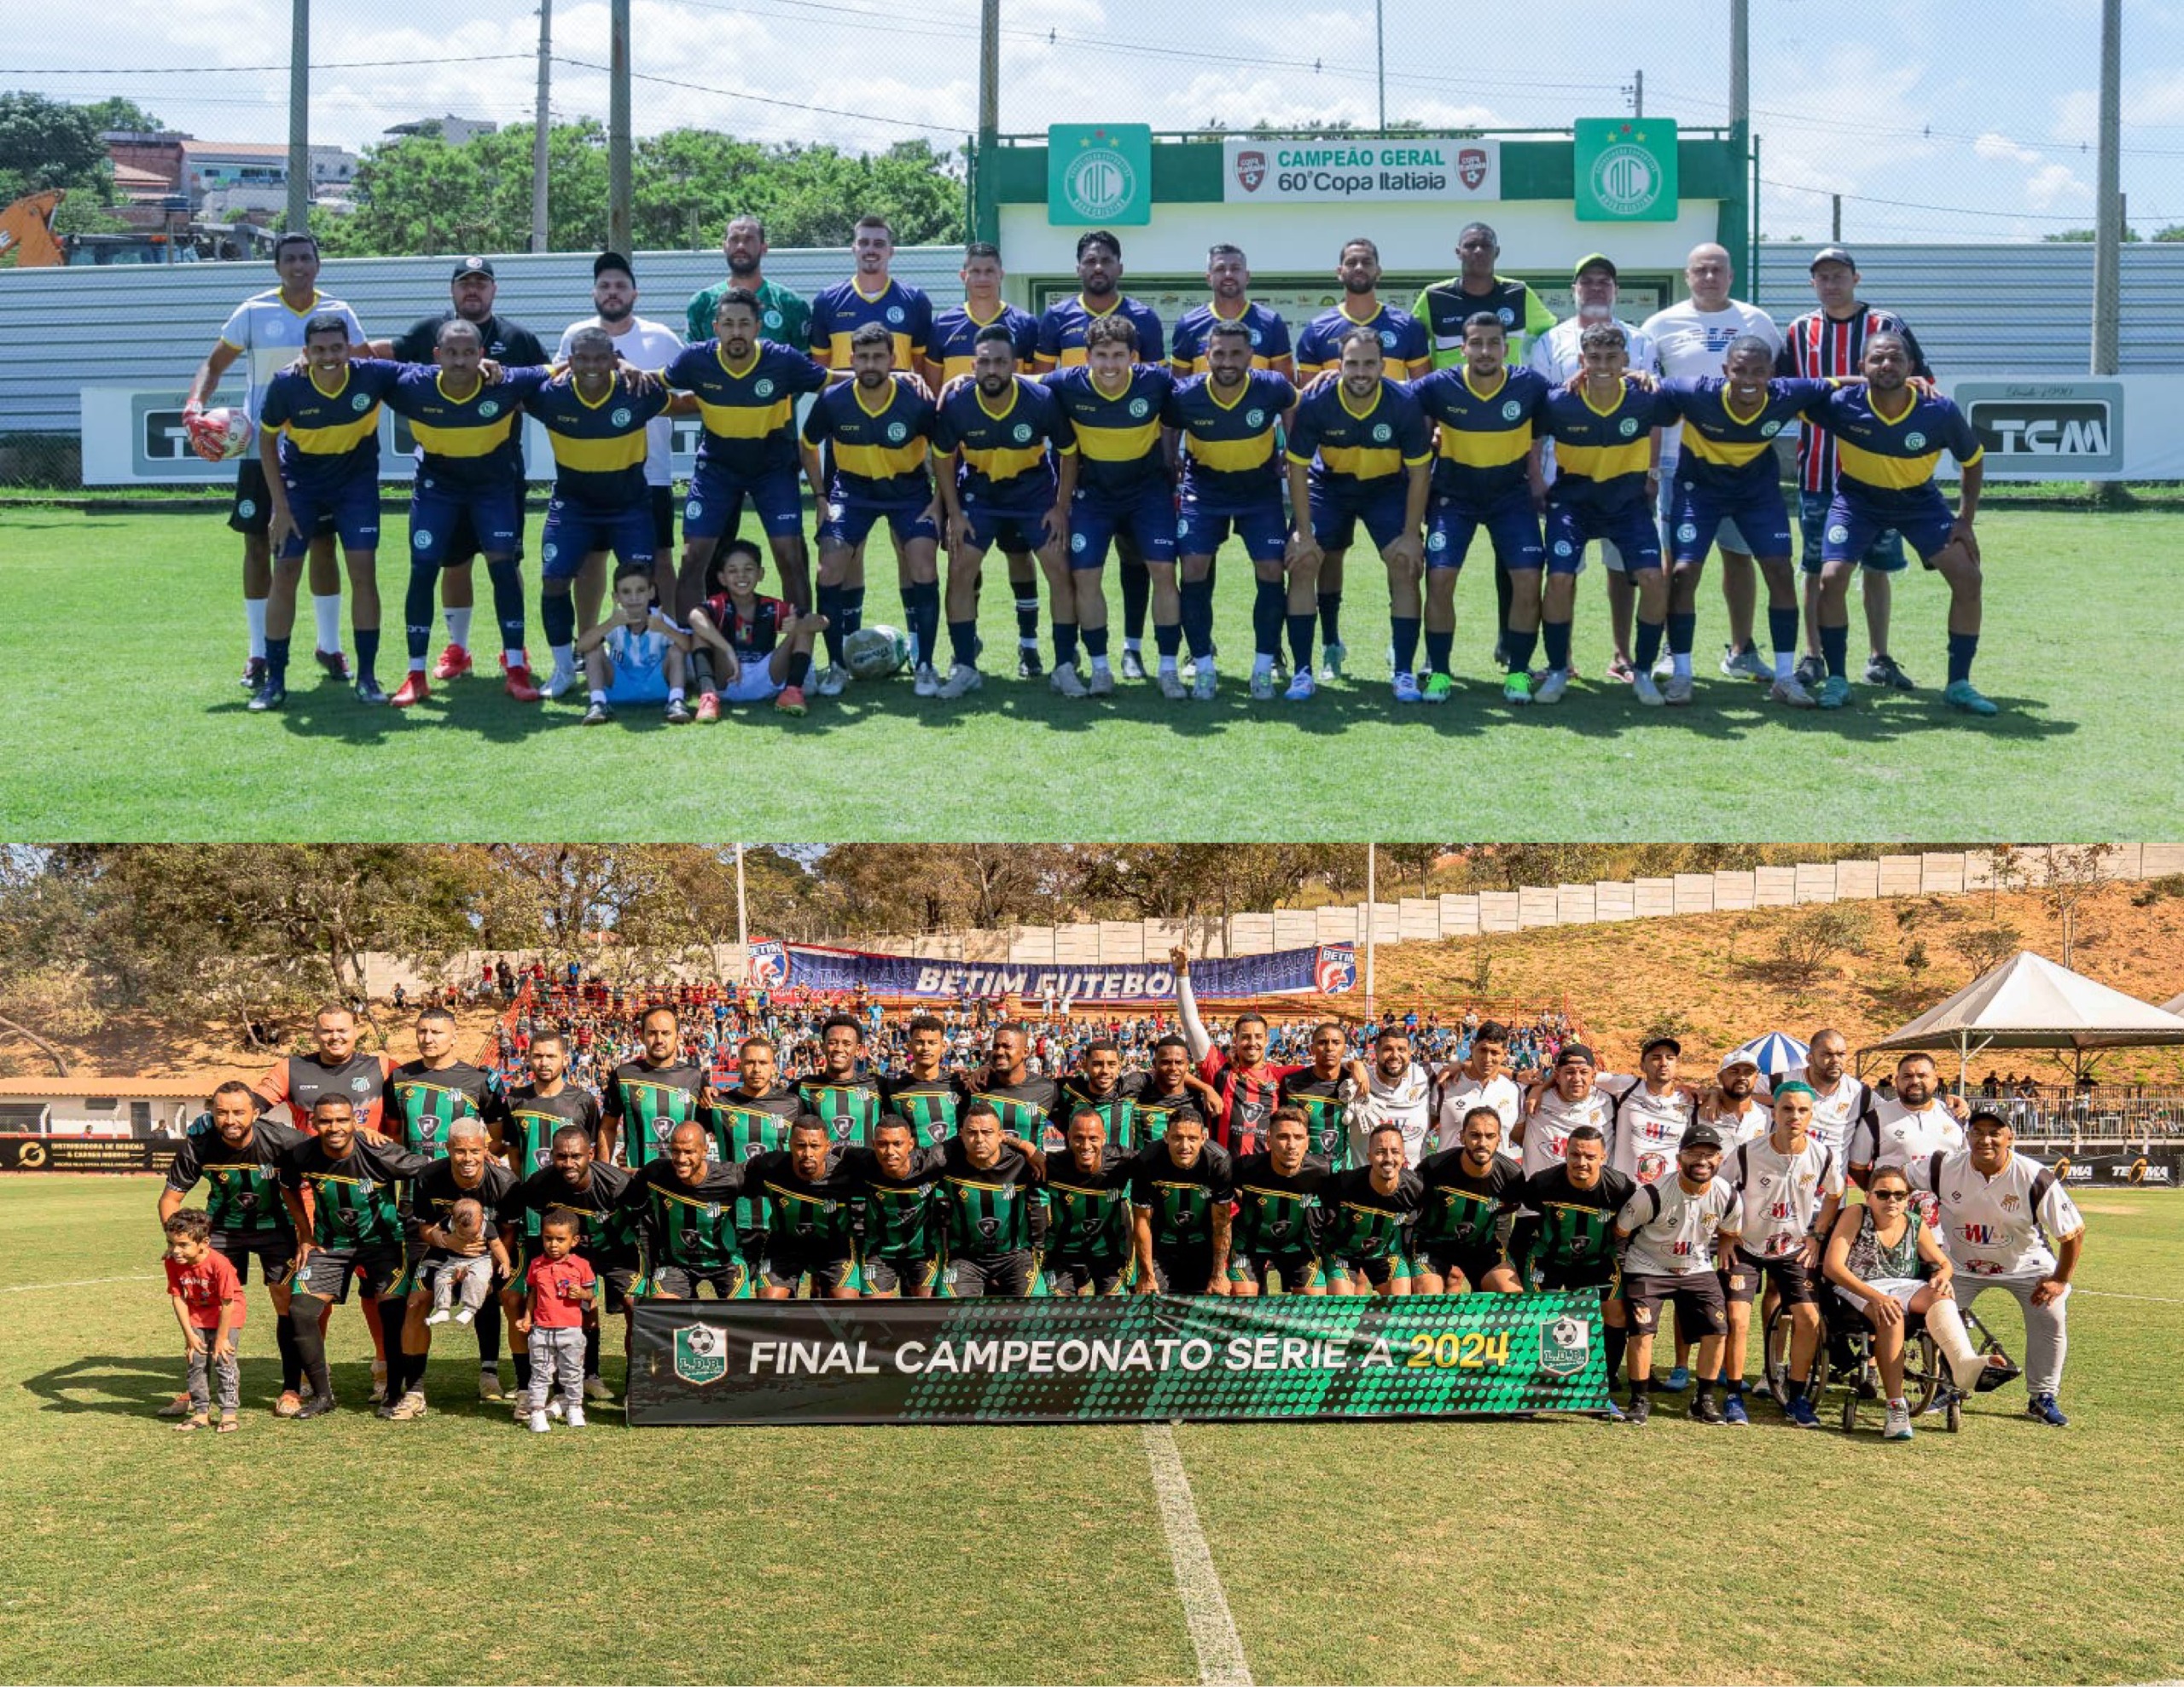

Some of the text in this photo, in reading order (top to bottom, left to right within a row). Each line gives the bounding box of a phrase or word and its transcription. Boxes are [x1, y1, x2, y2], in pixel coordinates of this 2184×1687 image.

[1278, 147, 1445, 167] CAMPEÃO GERAL
[1314, 171, 1373, 194] Copa
[1380, 171, 1445, 191] Itatiaia
[1991, 419, 2109, 455] TCM
[915, 965, 1029, 994] BETIM
[1034, 971, 1177, 998] FUTEBO
[749, 1331, 1510, 1374] FINAL CAMPEONATO SÉRIE A 2024
